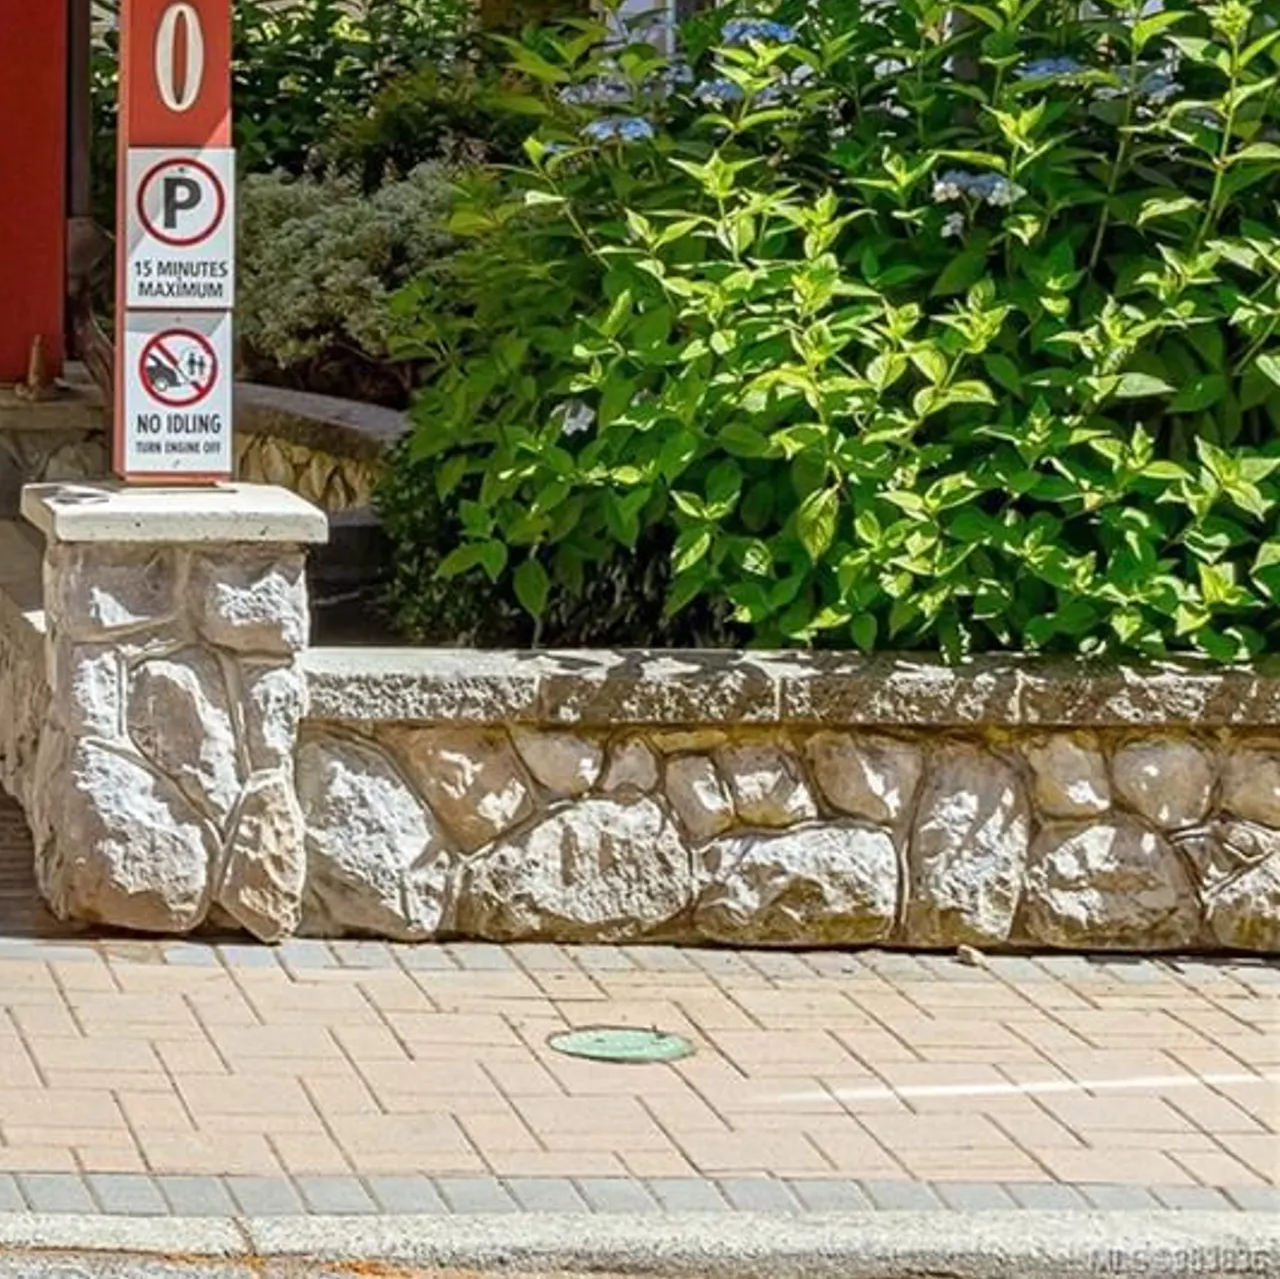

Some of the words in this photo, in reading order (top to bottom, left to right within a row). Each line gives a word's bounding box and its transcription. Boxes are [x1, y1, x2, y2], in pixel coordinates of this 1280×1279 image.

[163, 177, 201, 229] P
[135, 261, 152, 277] 15
[157, 261, 228, 277] MINUTES
[138, 281, 223, 298] MAXIMUM
[137, 414, 161, 433] NO
[167, 414, 221, 434] IDLING
[136, 441, 161, 453] TURN
[165, 441, 200, 454] ENGINE
[204, 441, 221, 454] OFF
